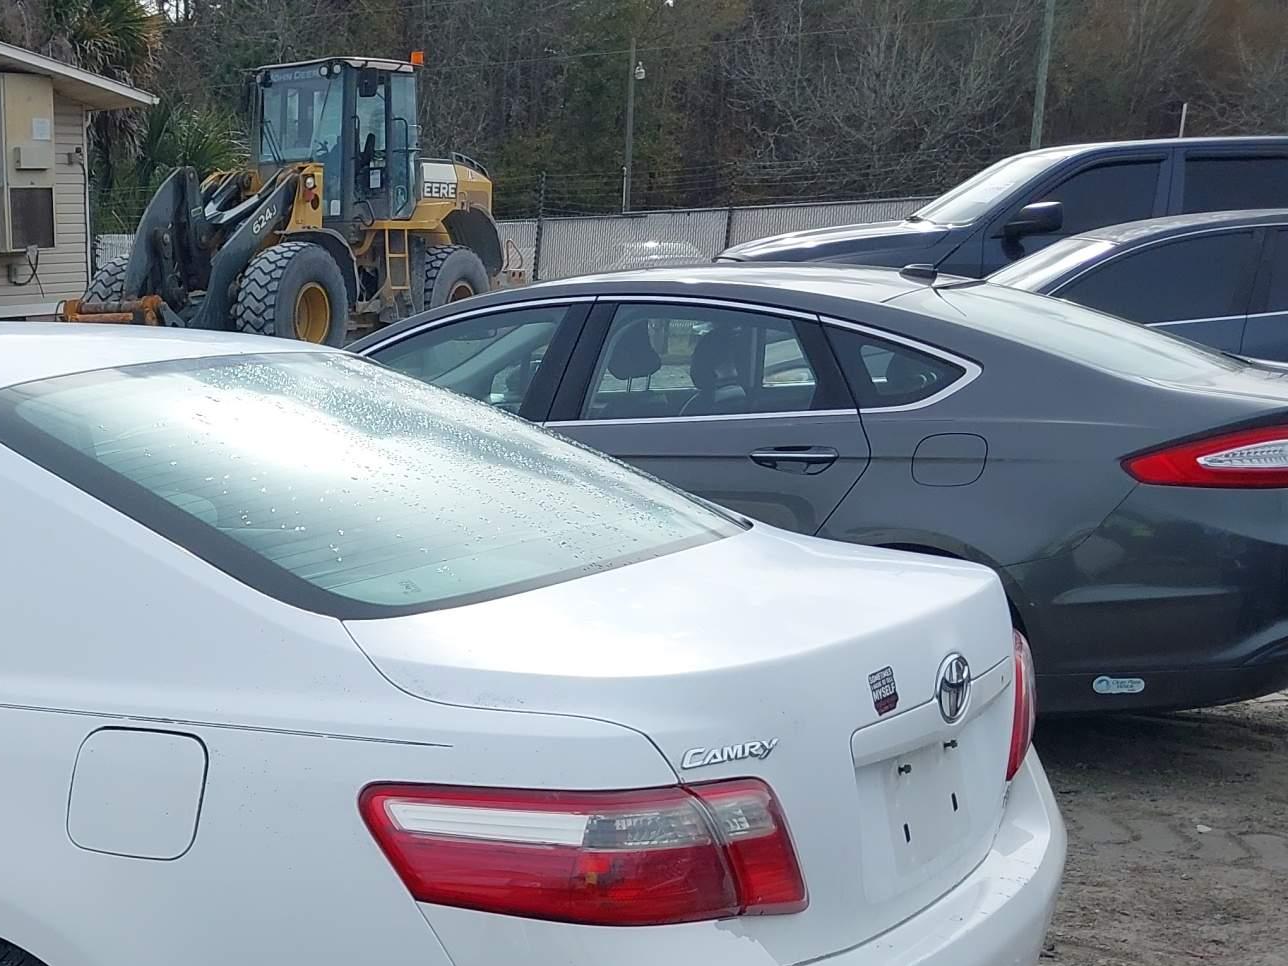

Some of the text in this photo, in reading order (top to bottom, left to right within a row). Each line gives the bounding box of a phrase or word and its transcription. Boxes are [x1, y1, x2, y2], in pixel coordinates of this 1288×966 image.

[423, 182, 456, 198] EERE
[252, 204, 277, 234] 624J
[872, 682, 896, 702] MYSELF
[681, 738, 779, 770] CAMRY
